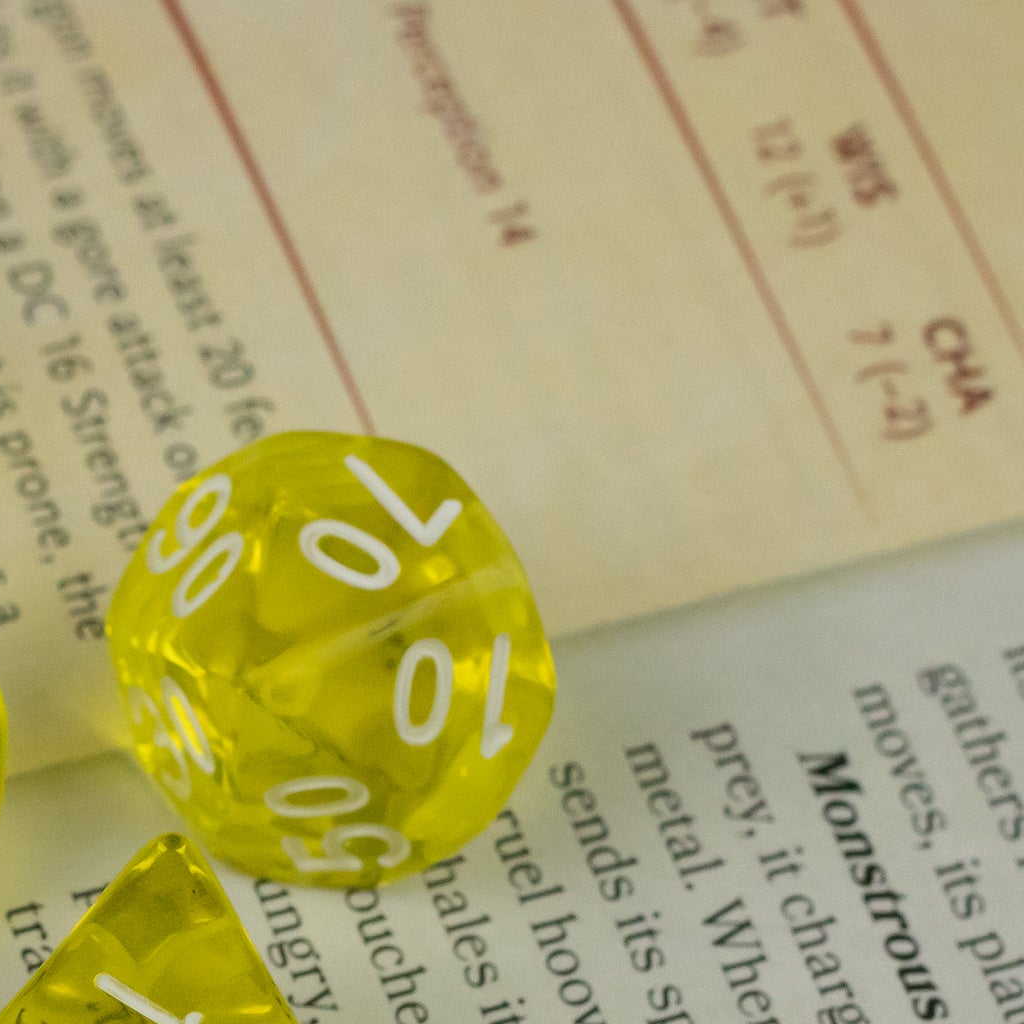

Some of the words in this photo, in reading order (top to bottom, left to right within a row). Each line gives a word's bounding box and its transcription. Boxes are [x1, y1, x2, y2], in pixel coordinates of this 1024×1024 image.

[79, 66, 152, 187] moves
[832, 124, 900, 208] WIS
[12, 99, 75, 180] with
[50, 219, 129, 304] gore
[105, 314, 194, 435] attack
[131, 196, 179, 232] at
[488, 200, 538, 248] 14
[4, 259, 72, 328] DC
[155, 232, 225, 334] least
[850, 320, 898, 347] 7
[38, 331, 95, 383] 16
[196, 336, 257, 391] 20
[922, 315, 995, 416] CHA
[58, 387, 150, 553] Strengt
[223, 396, 277, 441] fe
[146, 472, 245, 618] 90
[298, 453, 463, 591] 70
[56, 571, 109, 641] the
[393, 632, 514, 760] 10
[917, 663, 1024, 843] gathers
[263, 775, 412, 873] 50
[624, 741, 727, 892] metal.
[688, 721, 775, 839] prey,
[757, 845, 805, 883] it
[851, 683, 948, 852] moves,
[933, 857, 986, 921] its
[424, 854, 500, 990] hales
[548, 761, 640, 903] sends
[614, 910, 666, 974] its
[797, 751, 950, 1023] Monstrous
